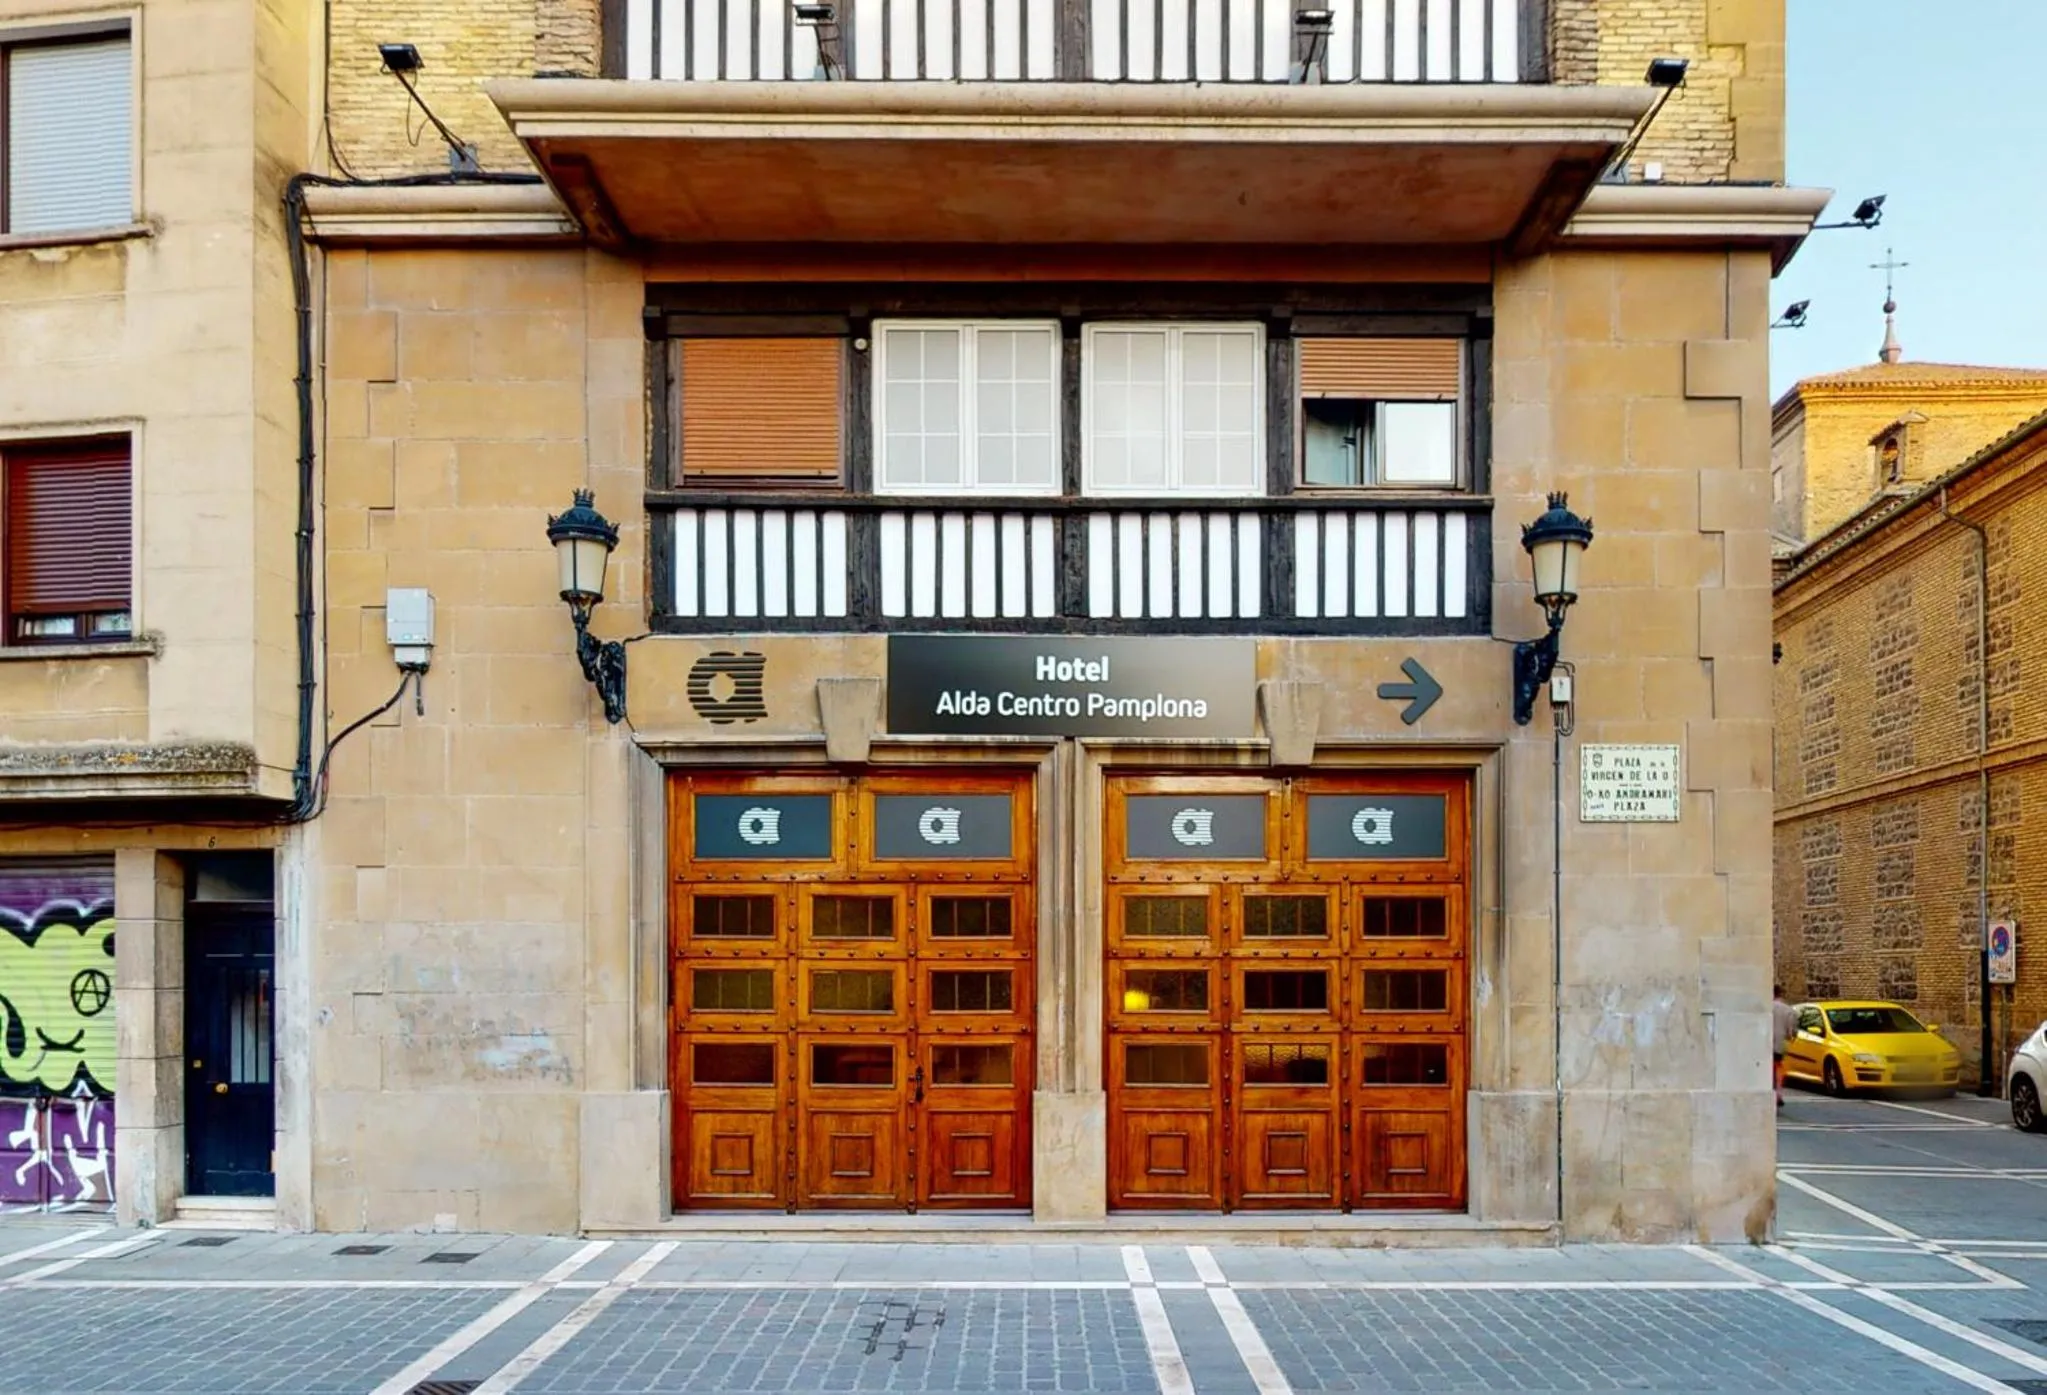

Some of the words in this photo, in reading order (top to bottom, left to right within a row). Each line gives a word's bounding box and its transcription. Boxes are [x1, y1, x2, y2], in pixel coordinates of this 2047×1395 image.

[1035, 655, 1109, 682] Hotel
[936, 690, 991, 716] Alda
[997, 691, 1080, 717] Centro
[1087, 693, 1208, 722] Pamplona
[1613, 757, 1641, 767] PLAZA
[1629, 771, 1642, 781] DE
[1646, 771, 1658, 781] LA
[1613, 801, 1646, 811] PLAZA
